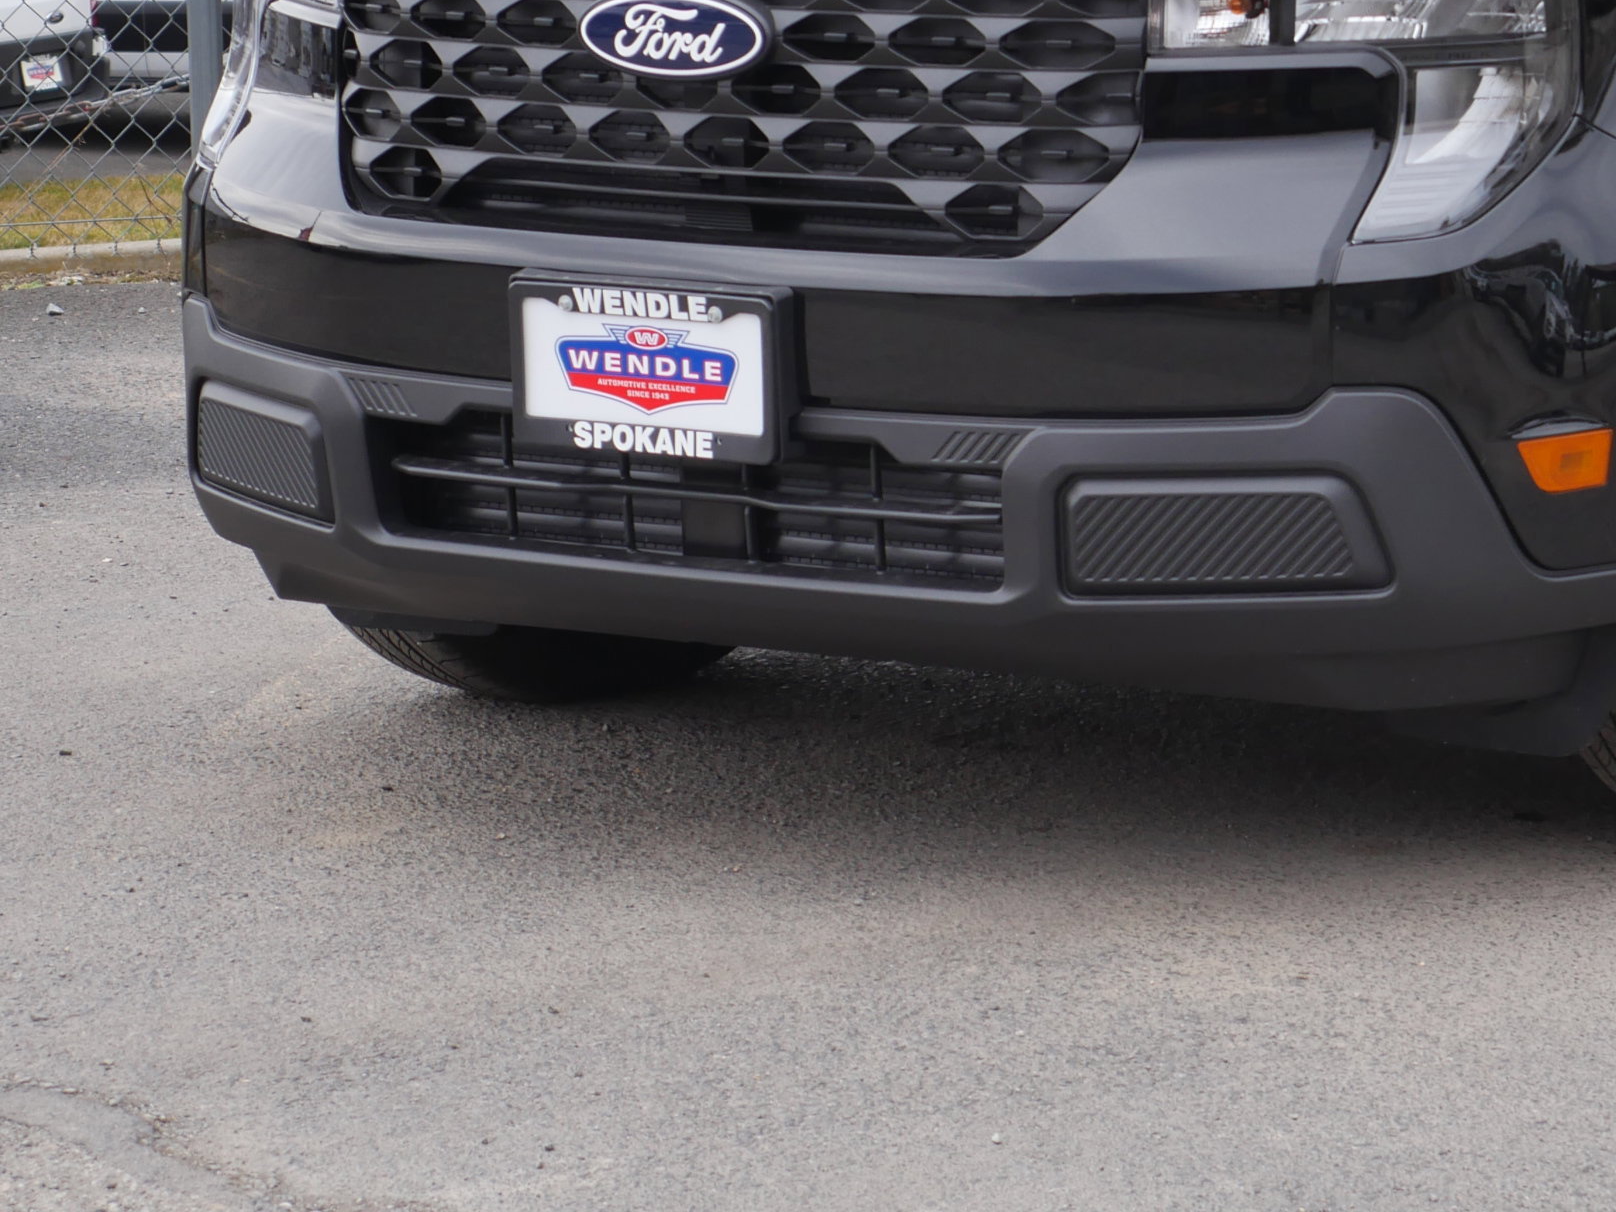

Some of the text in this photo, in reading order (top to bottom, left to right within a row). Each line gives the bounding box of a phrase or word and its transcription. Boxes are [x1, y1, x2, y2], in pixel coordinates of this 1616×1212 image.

[614, 3, 726, 63] Ford
[572, 287, 708, 322] WENDLE
[567, 348, 723, 382] WENDLE
[597, 378, 696, 394] AUTOMOTIVE EXCELLENCE
[626, 389, 651, 399] SINCE
[573, 420, 714, 459] SPOKANE
